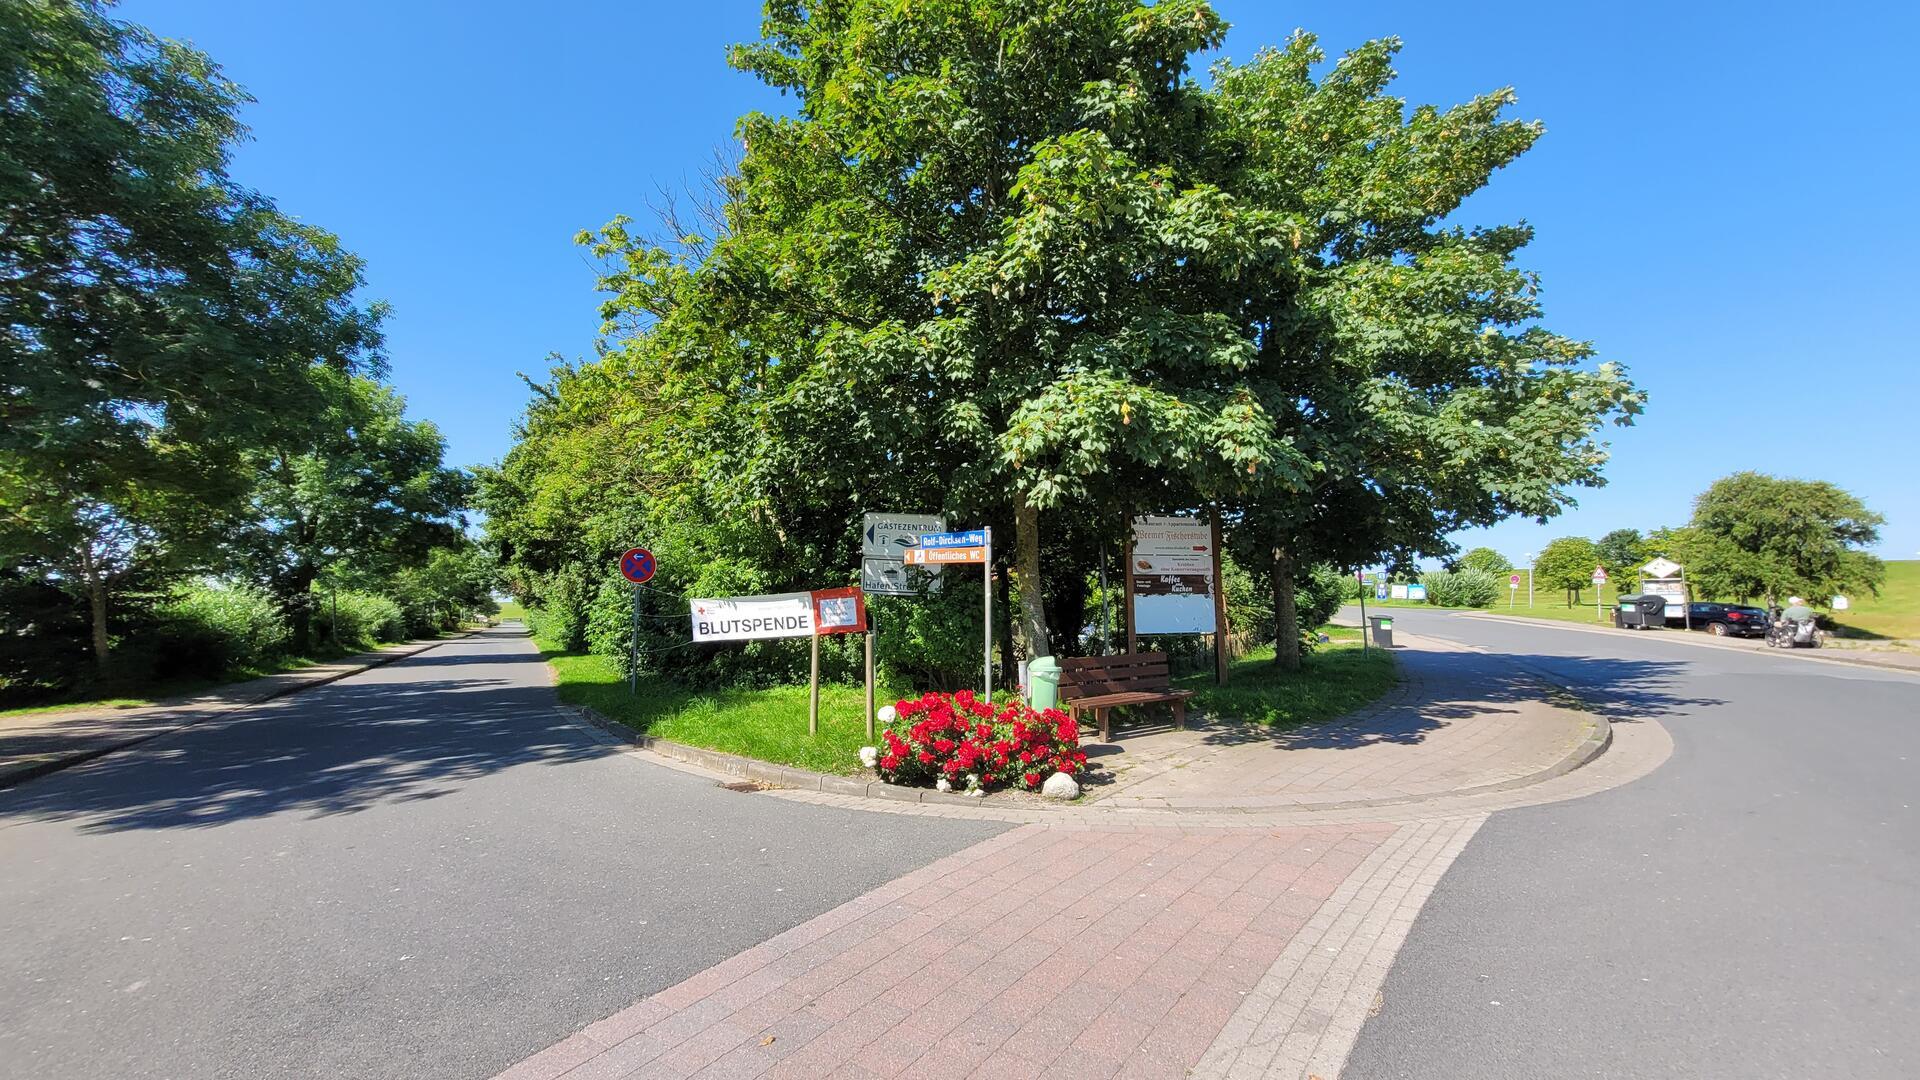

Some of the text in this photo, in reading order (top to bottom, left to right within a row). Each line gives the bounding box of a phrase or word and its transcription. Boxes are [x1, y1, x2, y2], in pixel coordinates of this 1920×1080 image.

[923, 534, 982, 546] Rolf-Dircksen-Weg
[928, 550, 980, 561] Öffentliches WC
[1160, 576, 1180, 584] Kaffee
[1171, 585, 1193, 593] Kuchen
[699, 615, 809, 635] BLUTSPENDE
